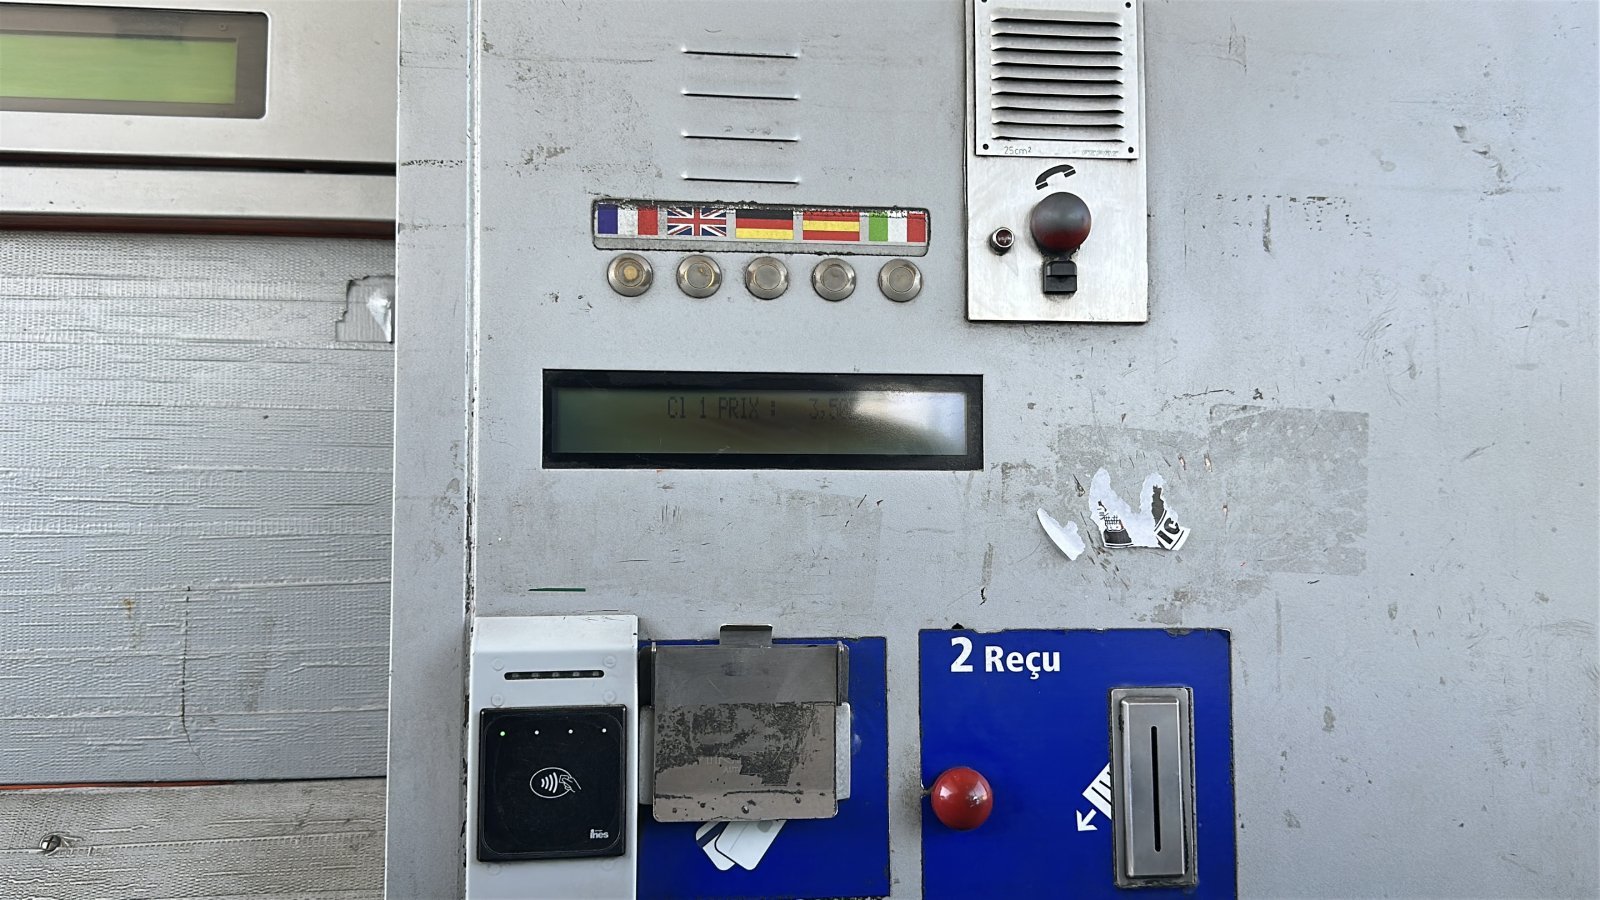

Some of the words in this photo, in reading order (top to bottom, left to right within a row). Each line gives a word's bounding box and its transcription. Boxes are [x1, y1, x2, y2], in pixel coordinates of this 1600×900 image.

[700, 396, 707, 419] 1
[718, 397, 759, 420] PRIX
[951, 636, 974, 673] 2
[985, 645, 1061, 680] Reçu
